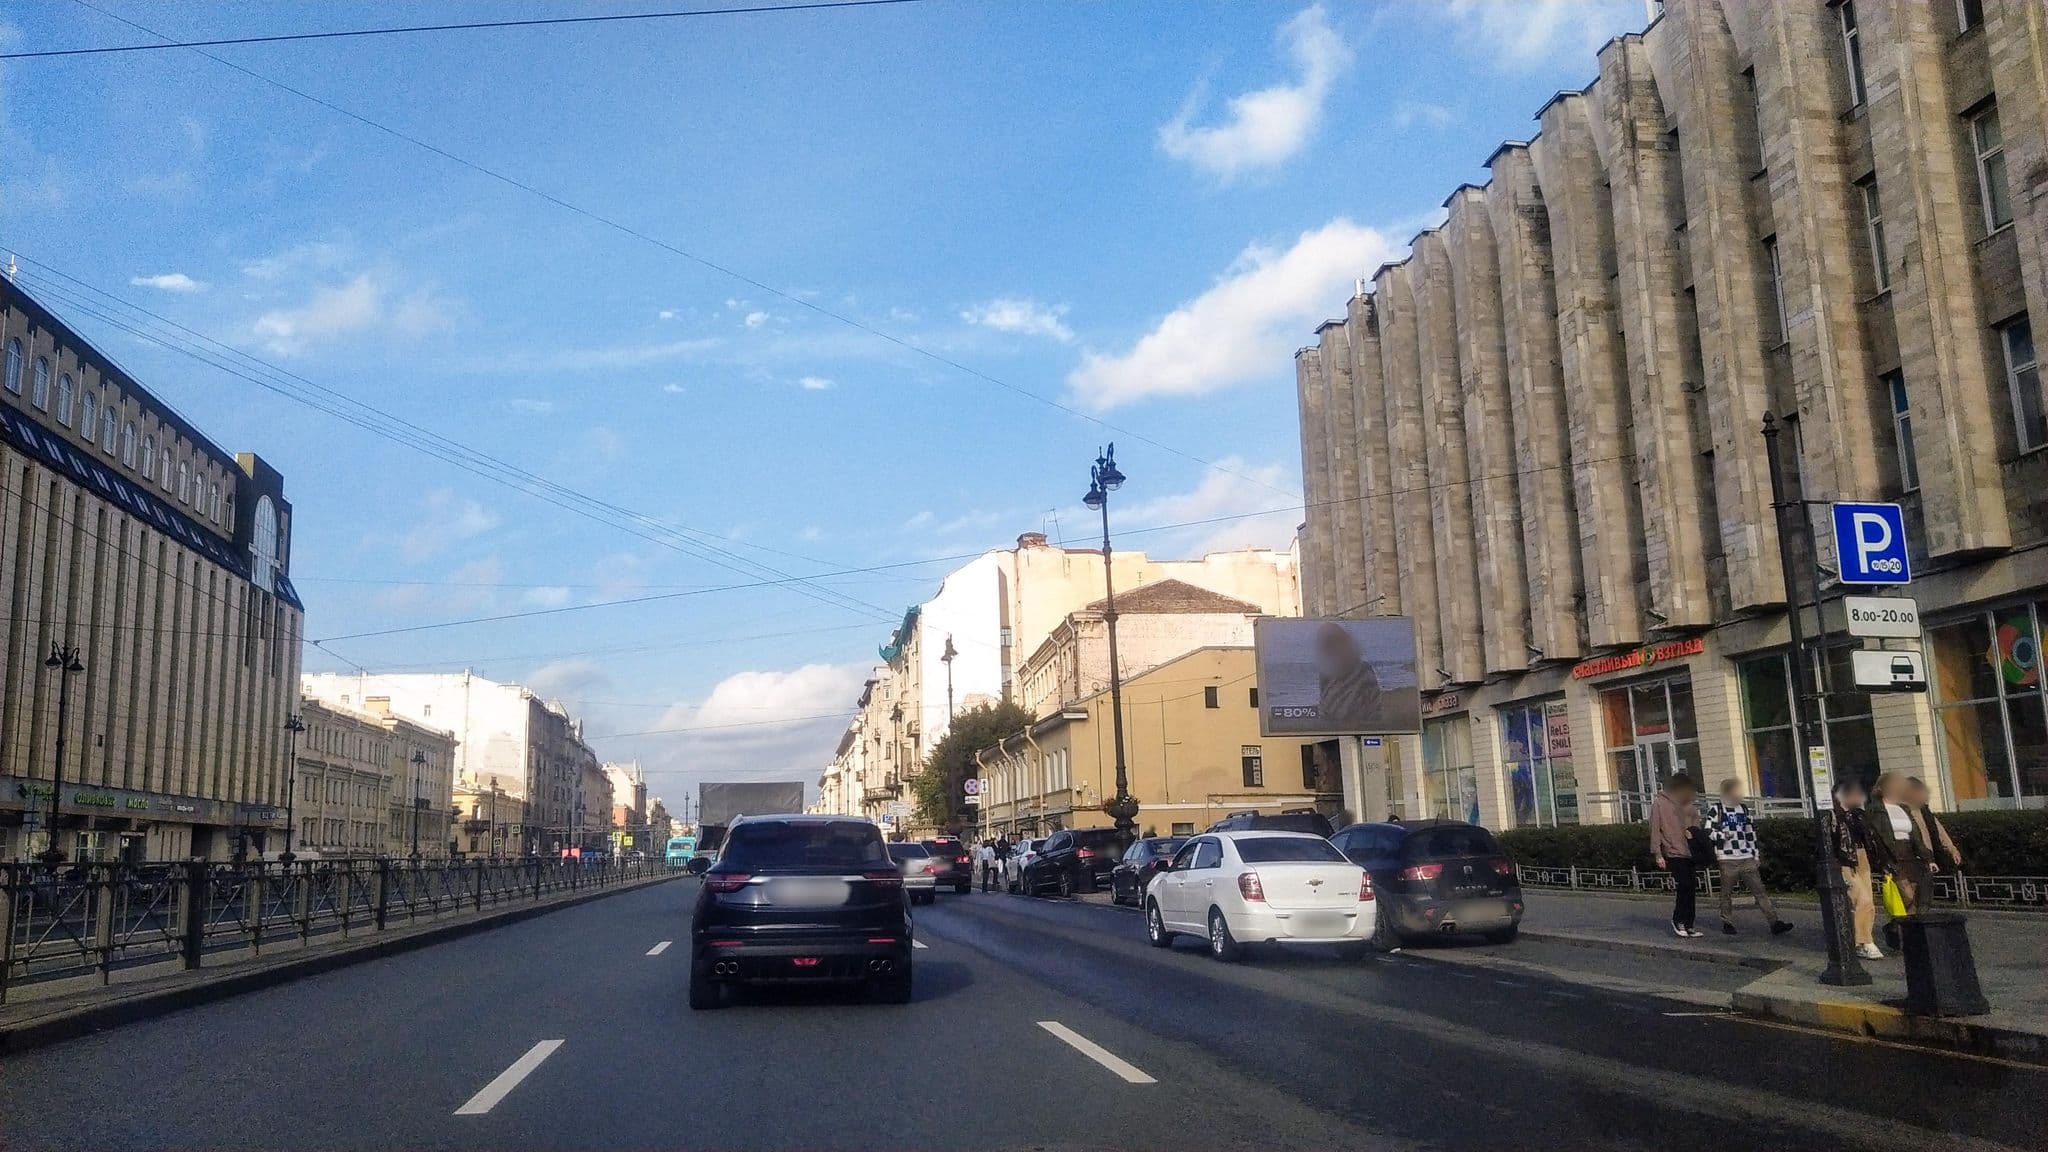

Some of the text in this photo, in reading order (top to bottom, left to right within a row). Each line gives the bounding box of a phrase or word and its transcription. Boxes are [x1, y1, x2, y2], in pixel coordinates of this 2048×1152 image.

[1853, 512, 1892, 574] P
[1890, 560, 1901, 571] 20
[1852, 608, 1914, 624] 8.00-20.00
